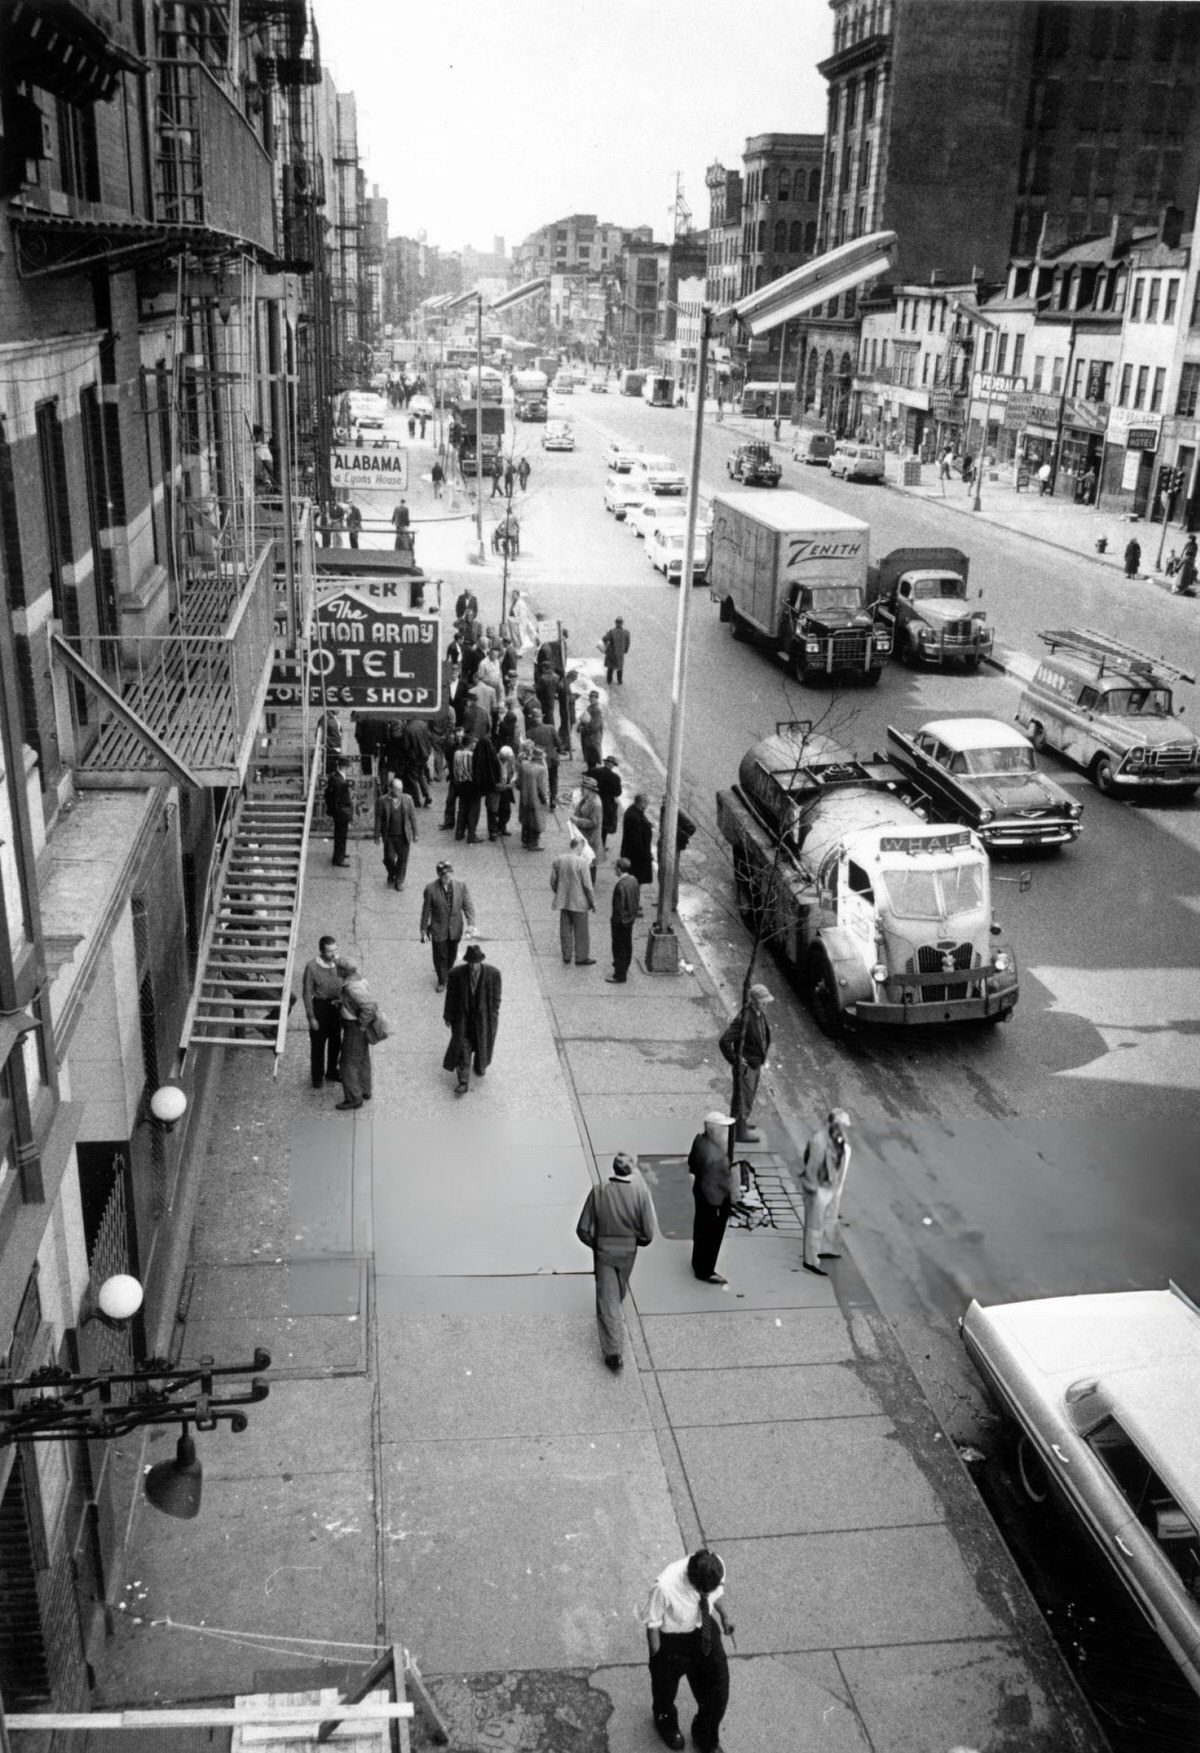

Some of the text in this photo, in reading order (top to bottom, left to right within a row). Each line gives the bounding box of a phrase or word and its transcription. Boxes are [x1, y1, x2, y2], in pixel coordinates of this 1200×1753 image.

[334, 454, 402, 473] ALABAMA
[344, 472, 372, 486] Lyons
[375, 474, 402, 485] House
[327, 600, 368, 620] The
[279, 648, 415, 679] HOTEL
[366, 687, 429, 703] SHOP
[883, 831, 970, 850] WHALE
